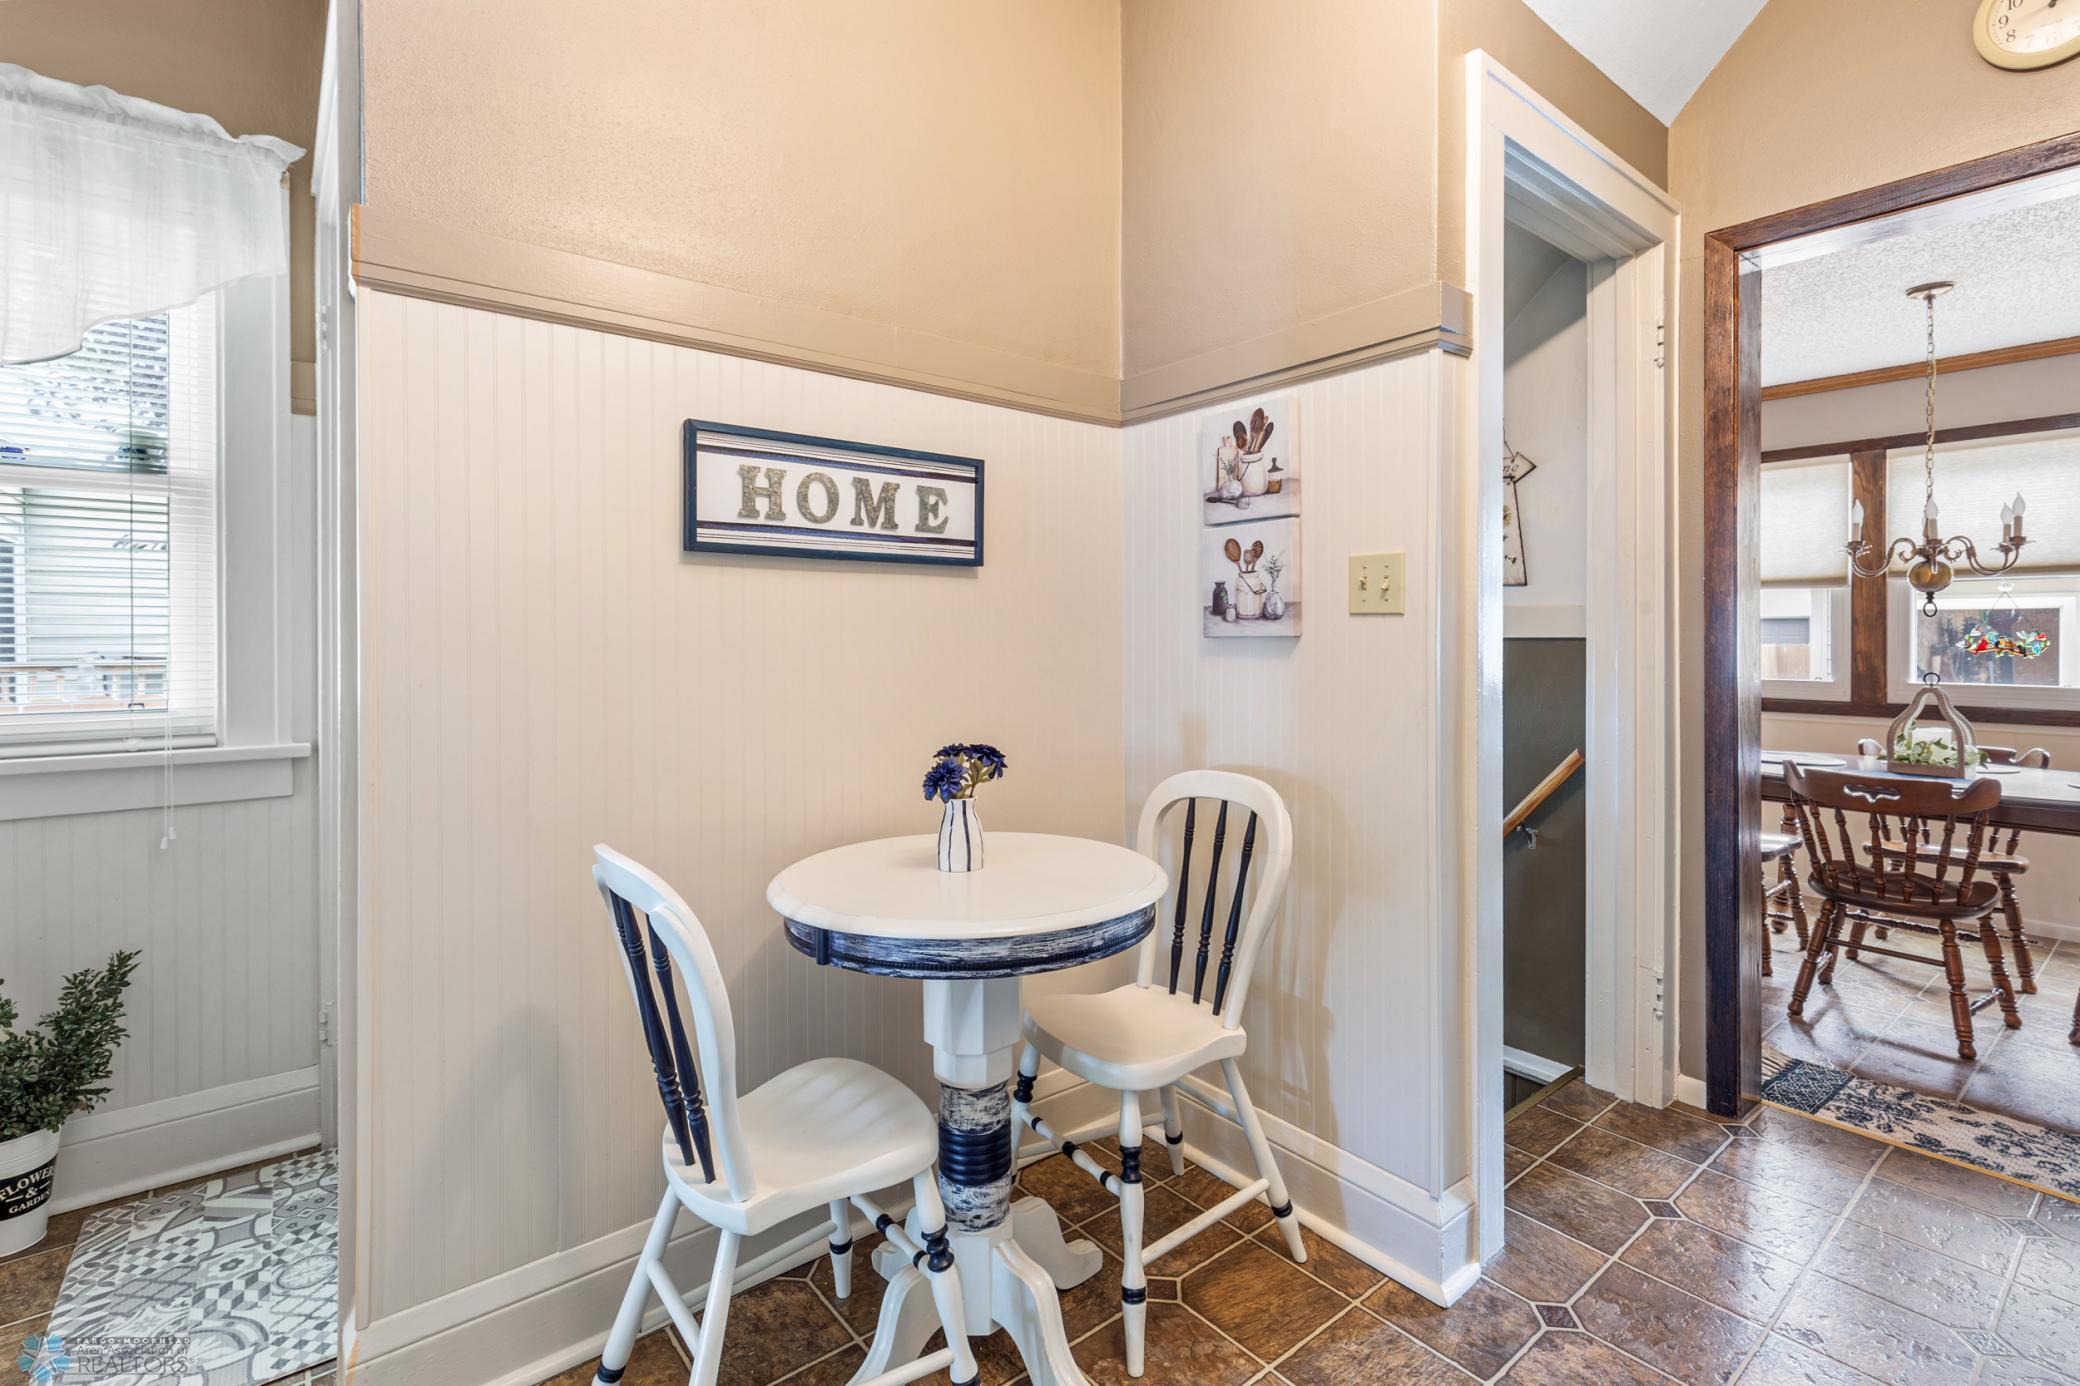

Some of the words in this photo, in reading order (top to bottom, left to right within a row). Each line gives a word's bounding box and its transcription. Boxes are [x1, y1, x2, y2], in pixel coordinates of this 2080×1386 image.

[1998, 15, 2009, 29] 9
[2006, 29, 2016, 43] 8
[736, 463, 950, 534] HOME
[25, 1187, 38, 1198] &
